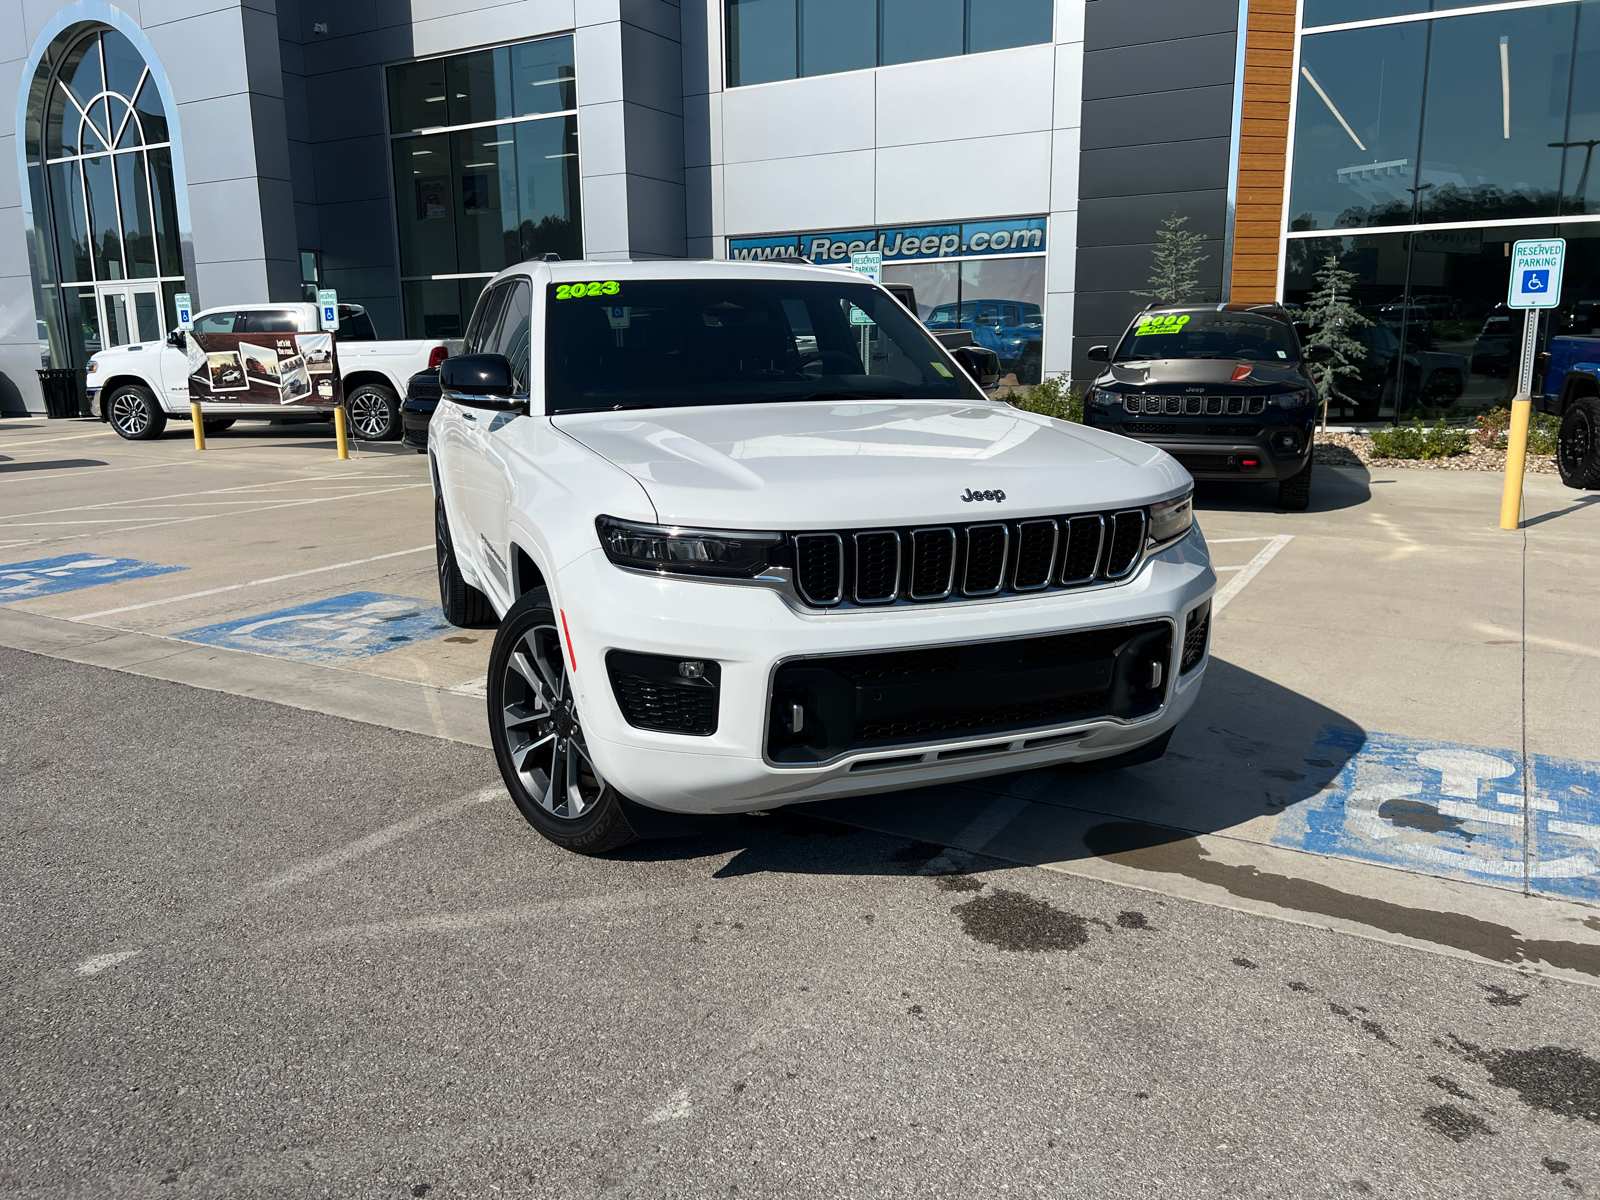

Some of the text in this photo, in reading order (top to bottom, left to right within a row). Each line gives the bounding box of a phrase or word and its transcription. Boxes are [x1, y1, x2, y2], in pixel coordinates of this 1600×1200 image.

[733, 228, 1042, 260] www.ReedJeep.com
[1517, 246, 1561, 256] RESERVED
[1518, 257, 1557, 267] PARKING
[556, 281, 620, 300] 2023
[961, 487, 1006, 503] Jeep
